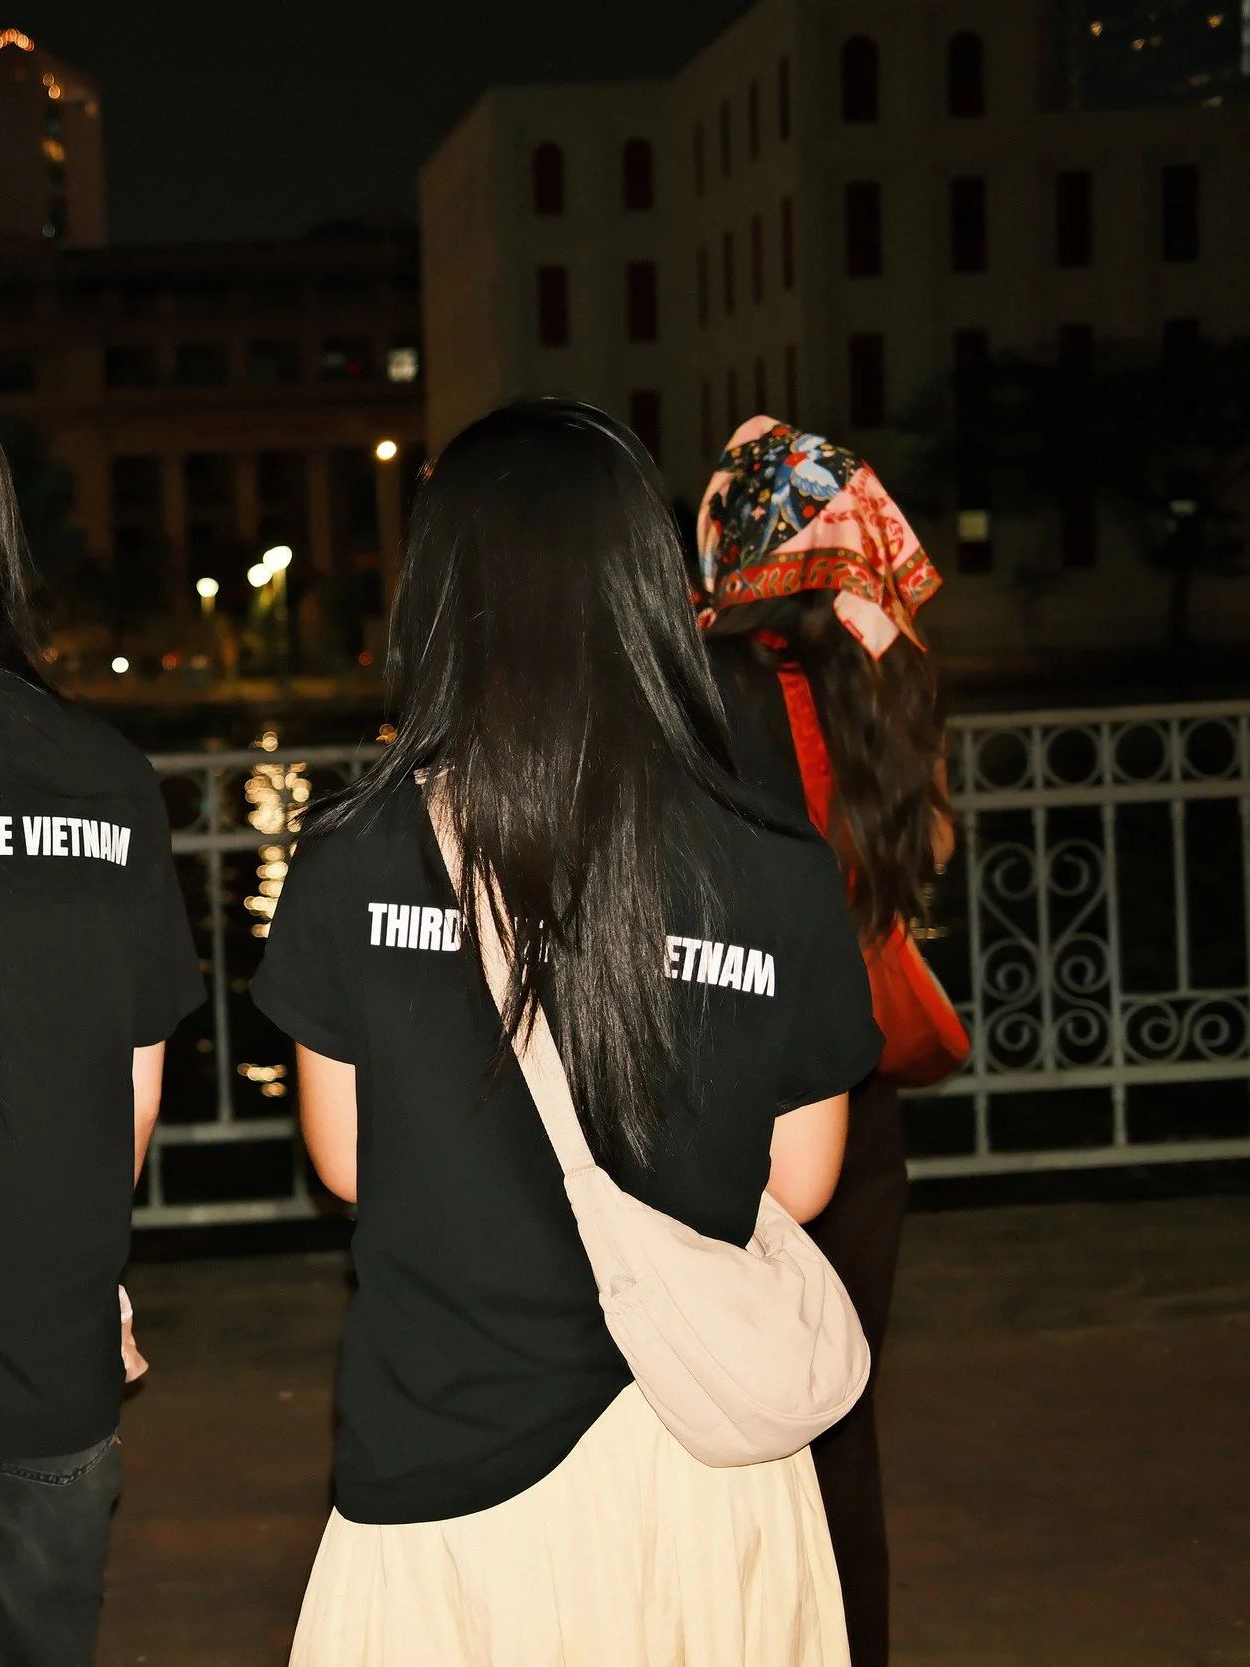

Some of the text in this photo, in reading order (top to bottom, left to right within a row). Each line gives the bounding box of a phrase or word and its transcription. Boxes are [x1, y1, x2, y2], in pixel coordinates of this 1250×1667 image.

[22, 816, 132, 867] VIETNAM
[368, 902, 462, 952] THIRD
[663, 935, 776, 998] ETNAM
